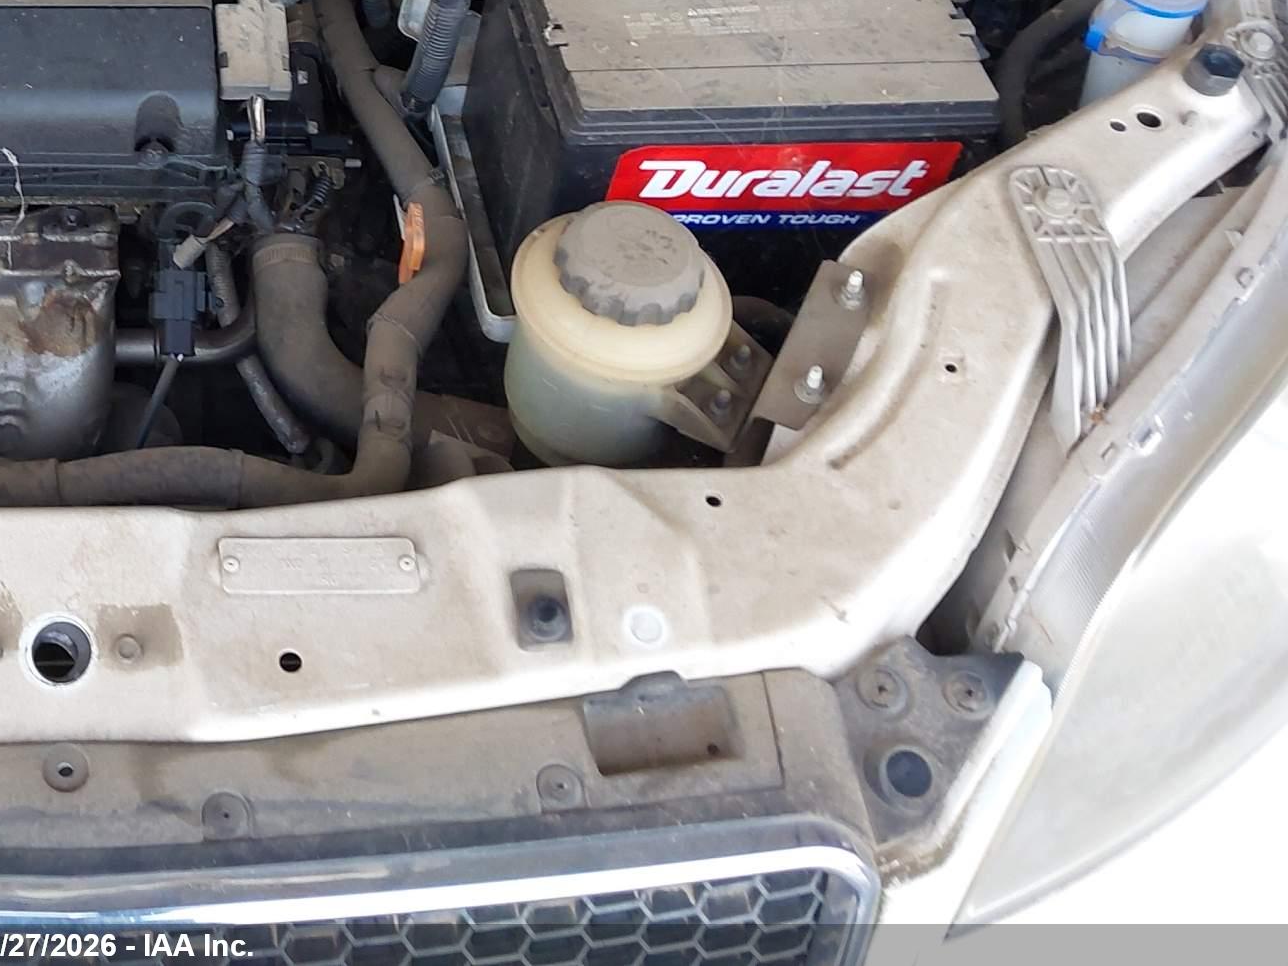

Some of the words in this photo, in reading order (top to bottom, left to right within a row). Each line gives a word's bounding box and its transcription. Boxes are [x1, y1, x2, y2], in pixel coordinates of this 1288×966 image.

[639, 160, 929, 198] Duralast
[672, 215, 772, 225] PROVEN
[778, 214, 861, 225] TOUGH
